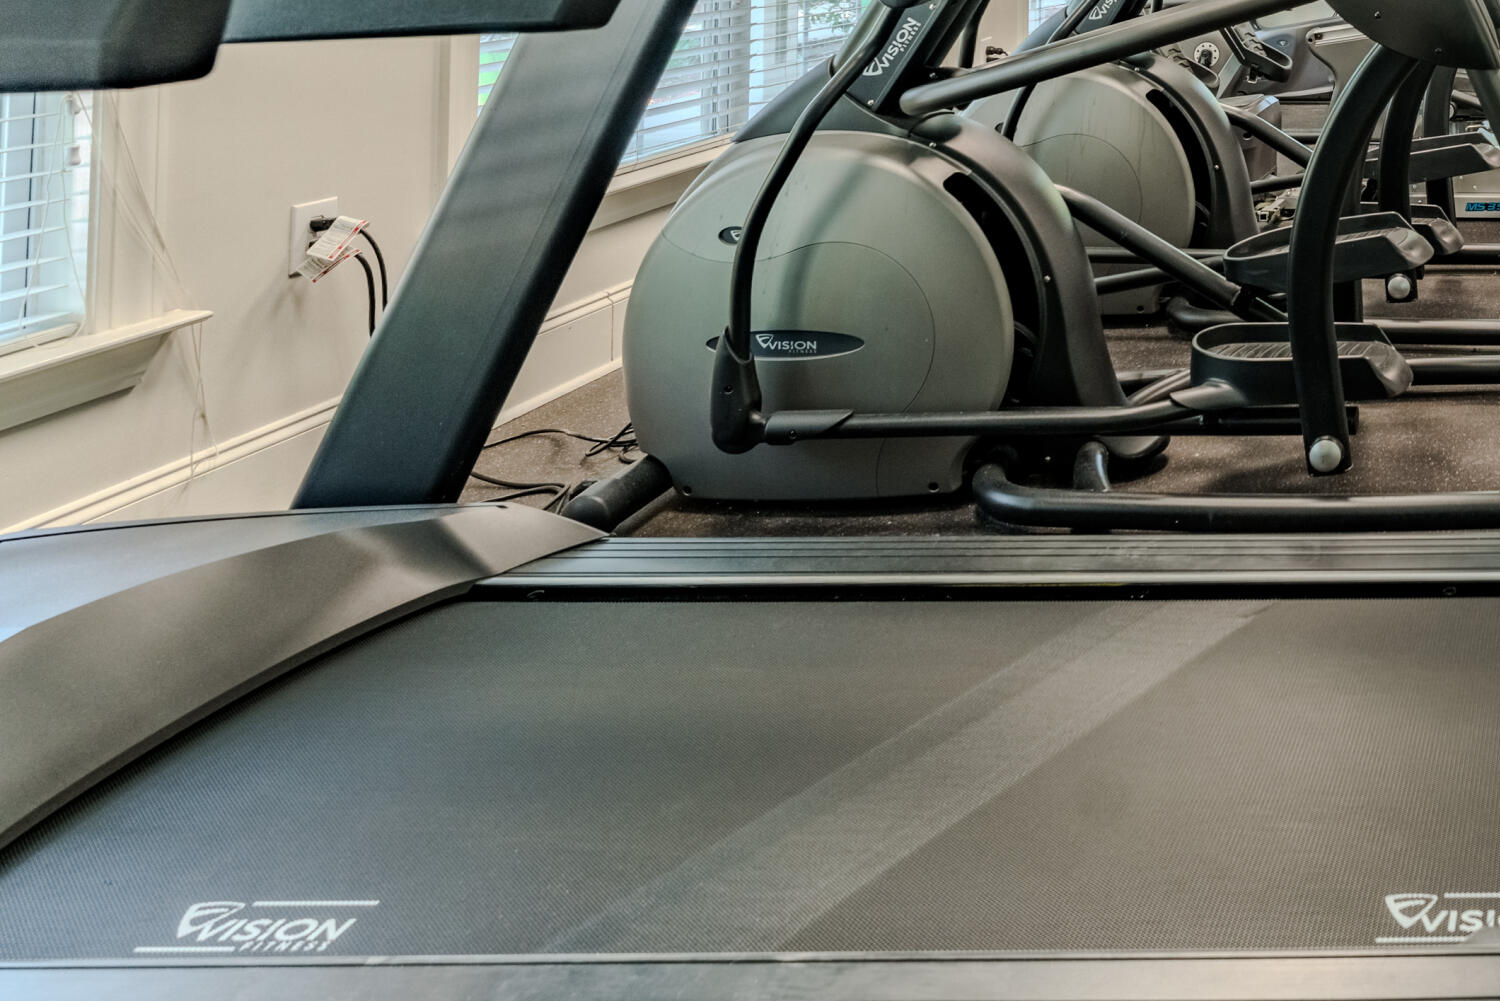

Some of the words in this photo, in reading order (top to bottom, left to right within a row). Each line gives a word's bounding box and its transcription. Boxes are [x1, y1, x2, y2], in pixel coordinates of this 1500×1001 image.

[879, 17, 918, 68] VISION
[769, 341, 817, 350] VISION
[196, 918, 357, 942] VISION
[238, 940, 332, 952] FITNESS
